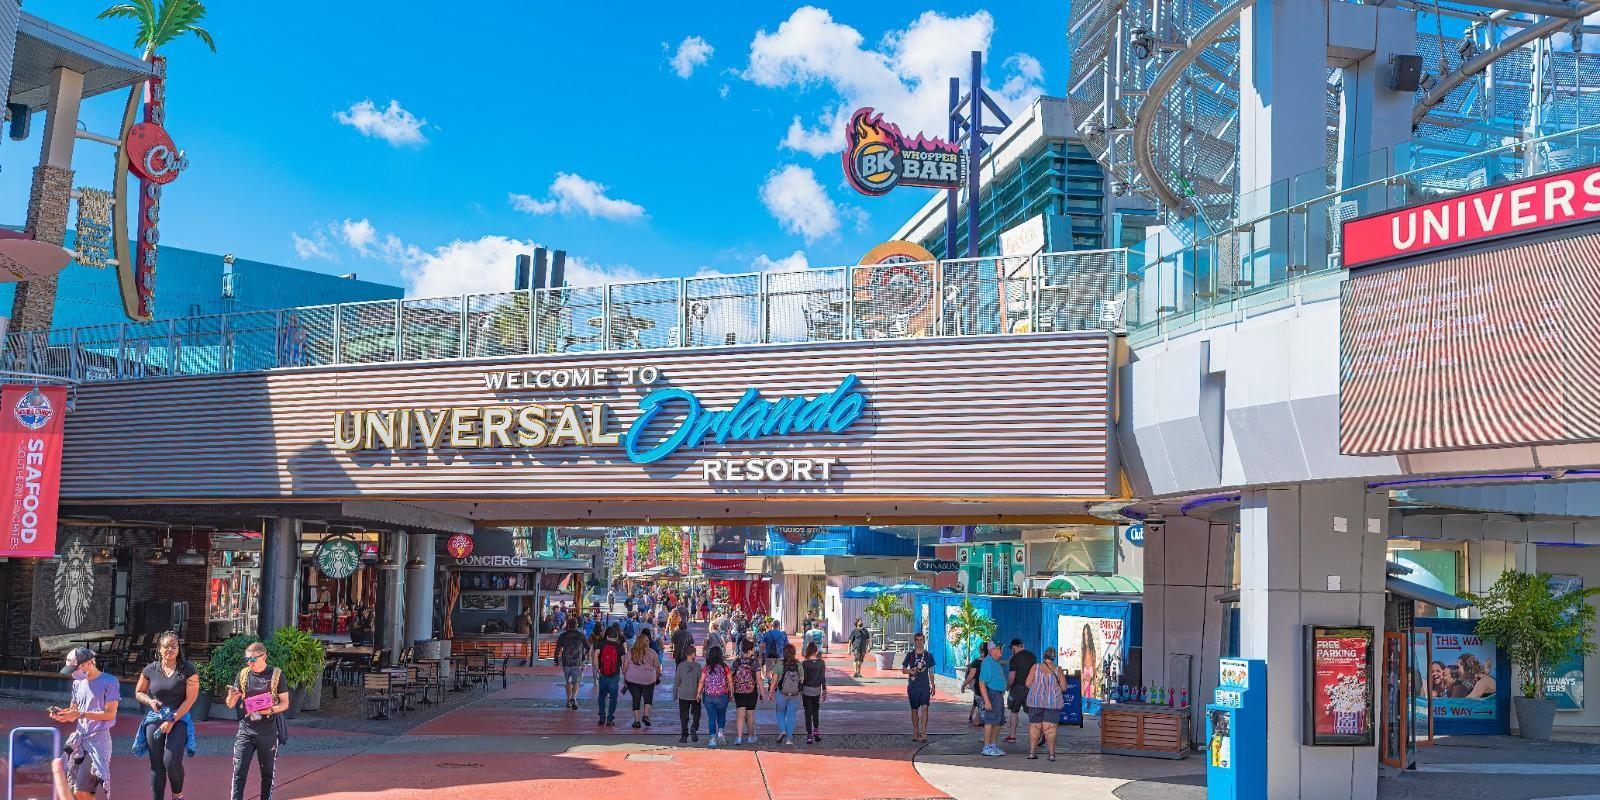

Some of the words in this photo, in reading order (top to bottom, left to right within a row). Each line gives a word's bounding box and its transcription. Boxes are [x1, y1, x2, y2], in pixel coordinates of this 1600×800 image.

[145, 144, 190, 178] Club
[862, 149, 896, 178] BK
[901, 150, 958, 162] WHOPPER
[902, 160, 958, 181] BAR
[484, 368, 609, 390] WELCOME
[621, 365, 660, 386] TO
[334, 403, 620, 450] UNIVERSAL
[623, 373, 869, 464] Orlando
[702, 457, 837, 482] RESORT
[20, 438, 44, 544] SEAFOOD
[456, 555, 528, 566] CONCIERGE
[1316, 640, 1340, 649] FREE
[1436, 636, 1459, 646] THIS
[1462, 636, 1485, 646] WAY
[1316, 649, 1357, 658] PARKING
[1432, 706, 1448, 717] HIS
[1451, 706, 1474, 717] WAY
